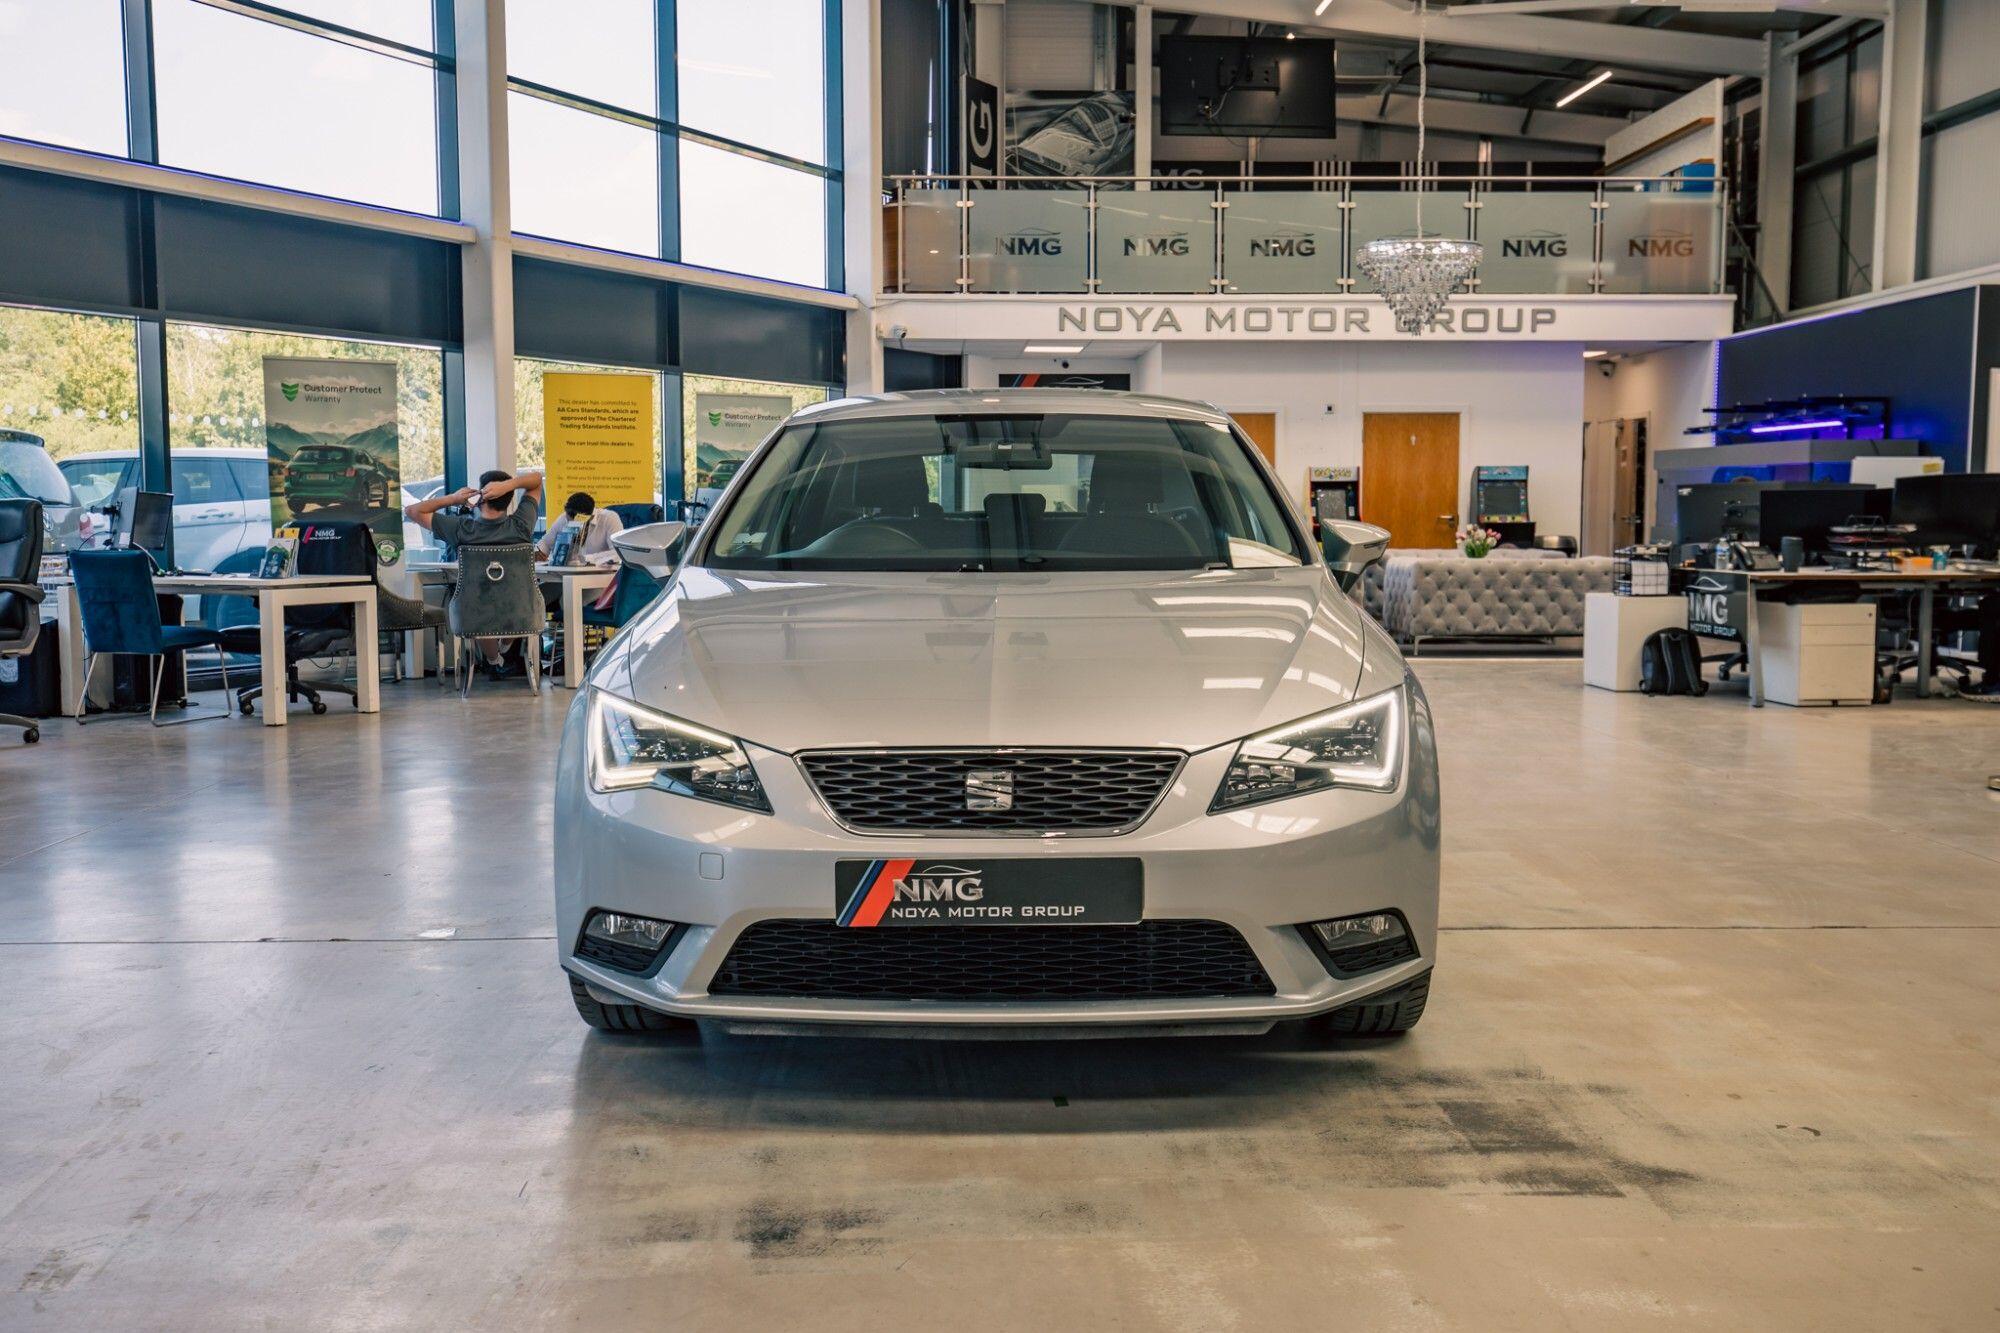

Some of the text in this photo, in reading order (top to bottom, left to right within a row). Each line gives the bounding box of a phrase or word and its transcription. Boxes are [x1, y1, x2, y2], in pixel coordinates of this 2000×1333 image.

[994, 237, 1062, 256] NMG
[1250, 238, 1316, 257] NMG
[1502, 239, 1568, 258] NMG
[1629, 239, 1695, 258] NMG
[1058, 306, 1182, 332] NOYA
[1206, 307, 1370, 332] MOTOR
[304, 384, 382, 394] Customer Protect
[305, 395, 341, 404] Warranty
[725, 413, 756, 421] Customer
[560, 423, 581, 431] Trading
[315, 529, 336, 537] NMG
[1713, 626, 1737, 637] GROUP
[892, 877, 984, 902] NMG
[892, 905, 1086, 918] NOYA MOTOR GROUP
